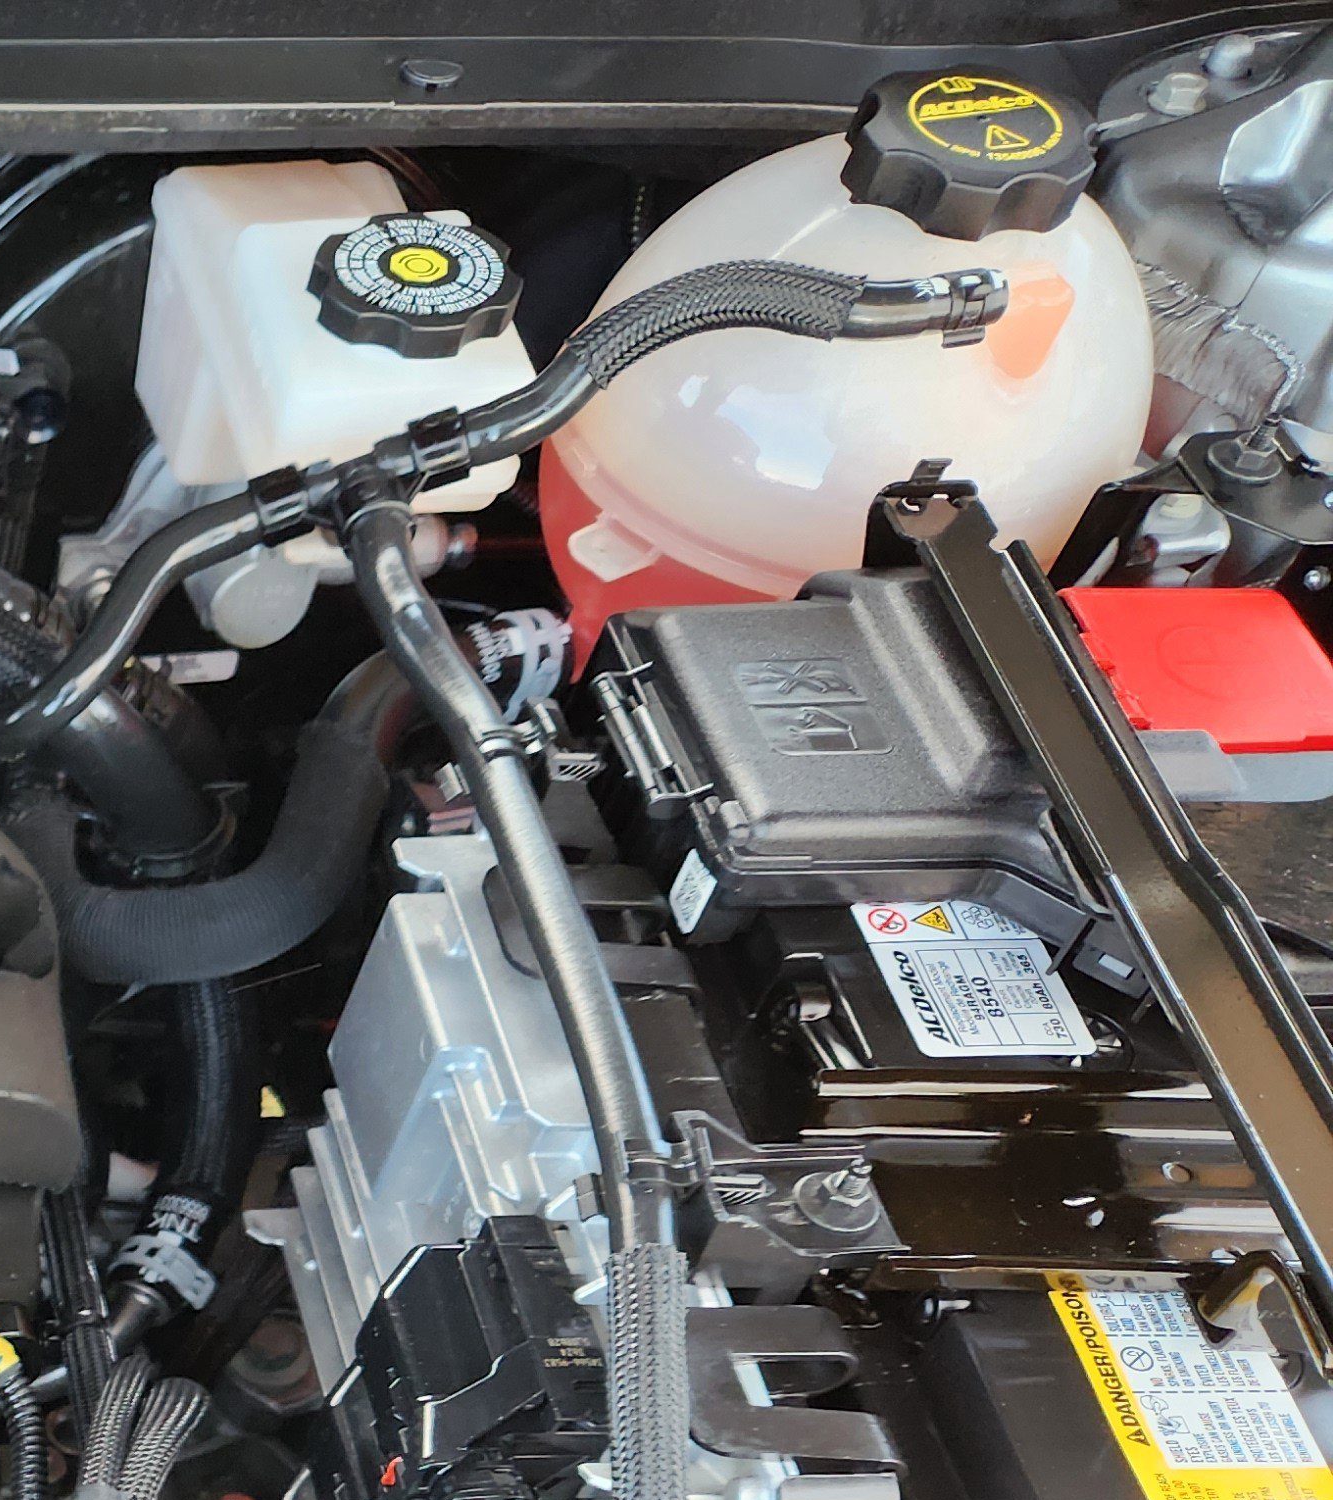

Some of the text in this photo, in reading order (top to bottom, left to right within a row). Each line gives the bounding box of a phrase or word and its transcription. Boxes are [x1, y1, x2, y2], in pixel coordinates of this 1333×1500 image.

[1017, 955, 1034, 974] 365
[893, 950, 951, 1043] ACDelco
[971, 977, 1004, 1017] 8540
[1050, 1018, 1067, 1038] 730
[1165, 1440, 1187, 1462] SHIELD
[1185, 1447, 1204, 1462] EYES
